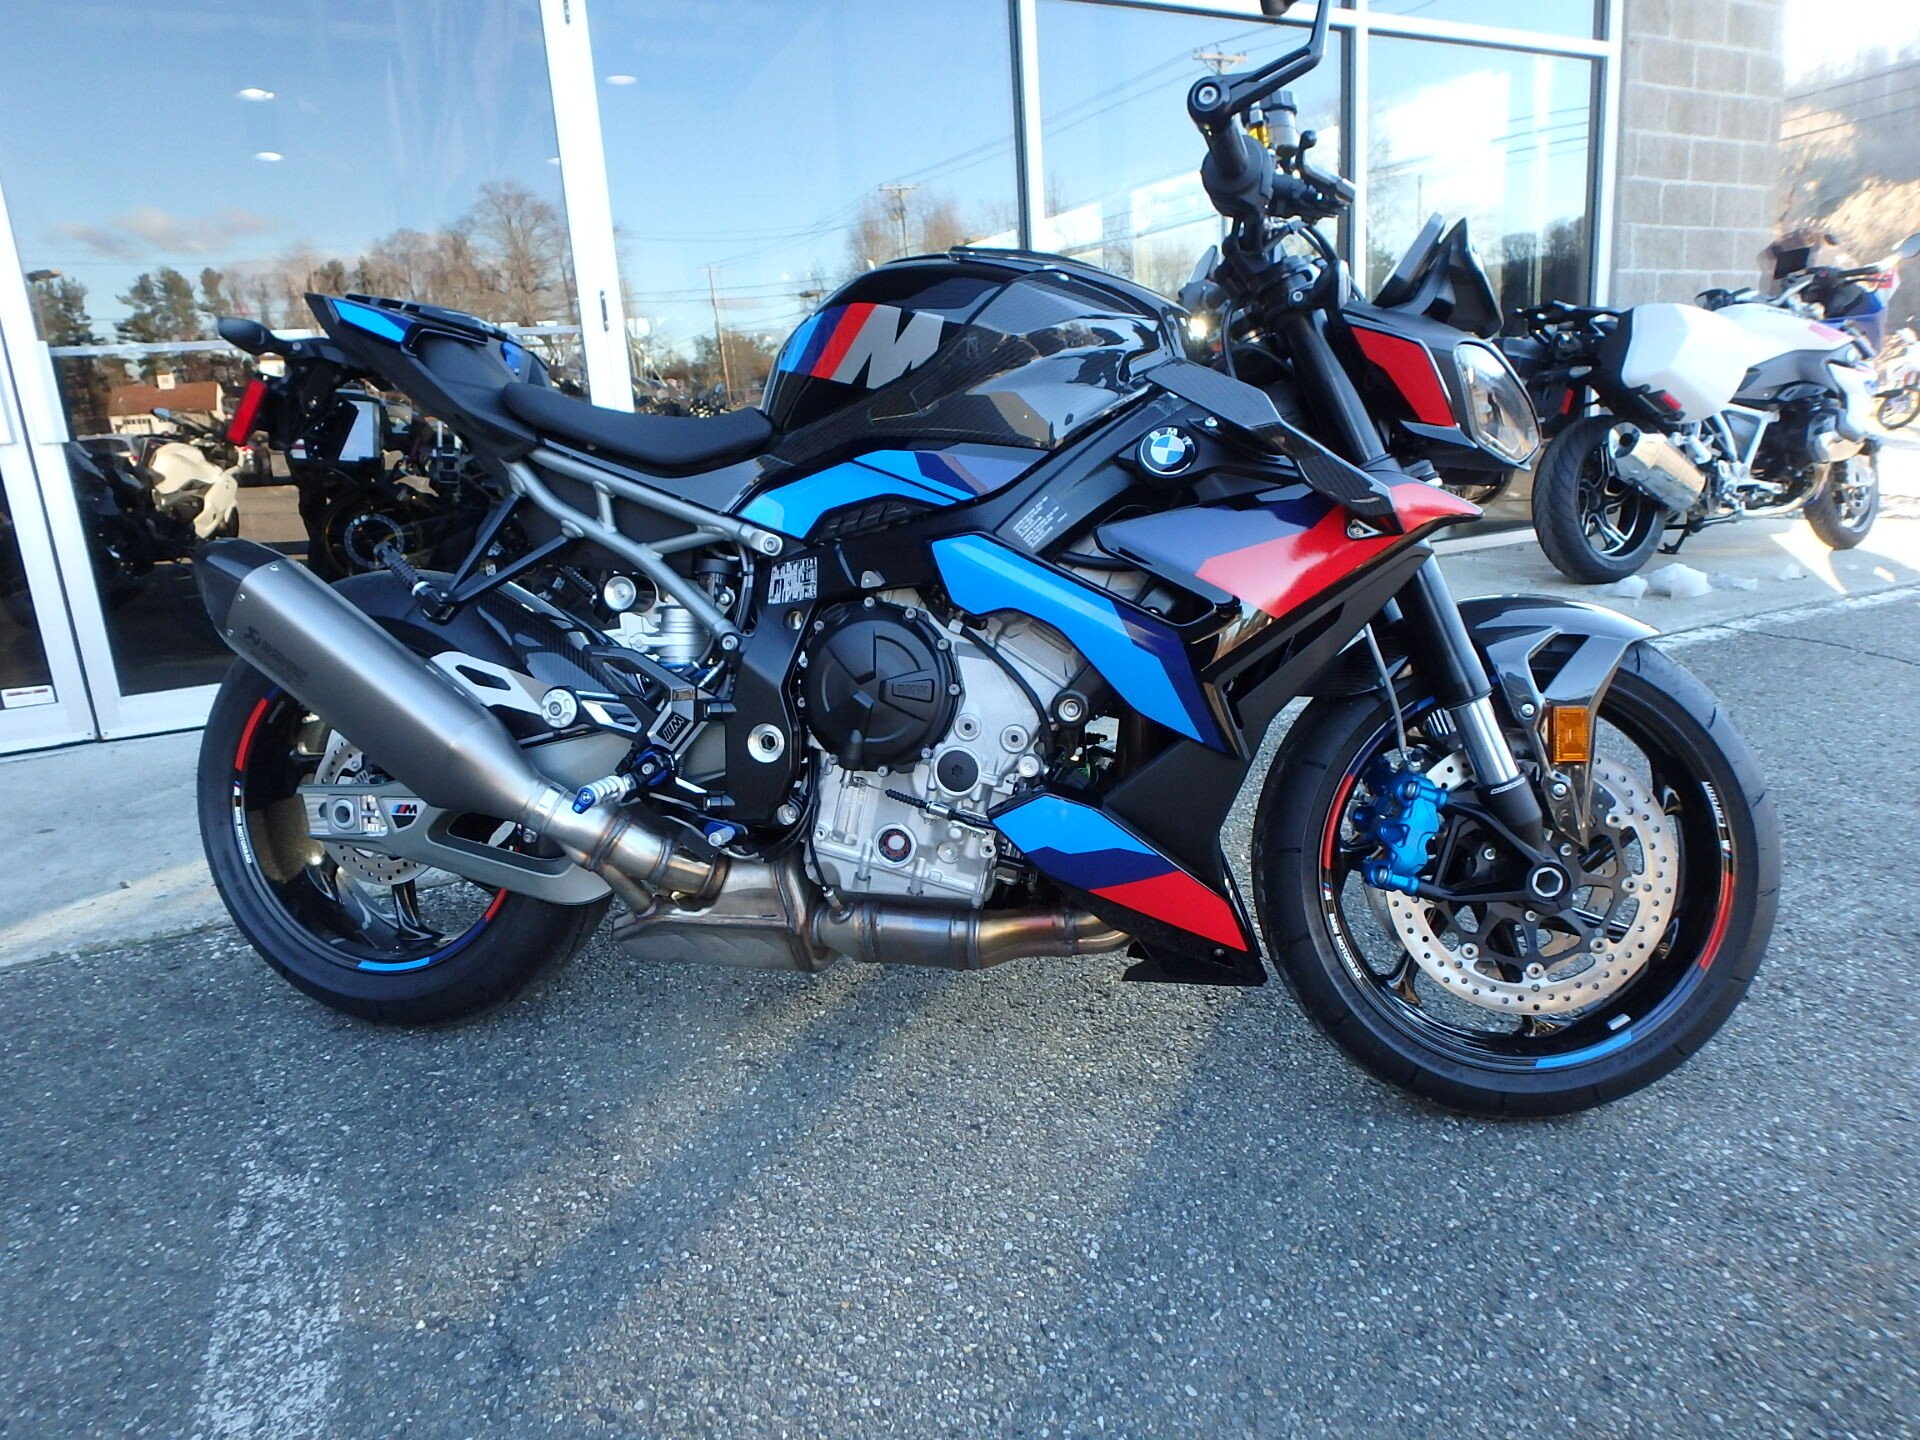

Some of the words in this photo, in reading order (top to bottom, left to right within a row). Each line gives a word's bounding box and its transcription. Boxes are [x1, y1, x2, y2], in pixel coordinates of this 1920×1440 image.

[830, 303, 945, 390] M
[1150, 426, 1193, 446] BMW
[1336, 936, 1361, 978] MOTORRAD
